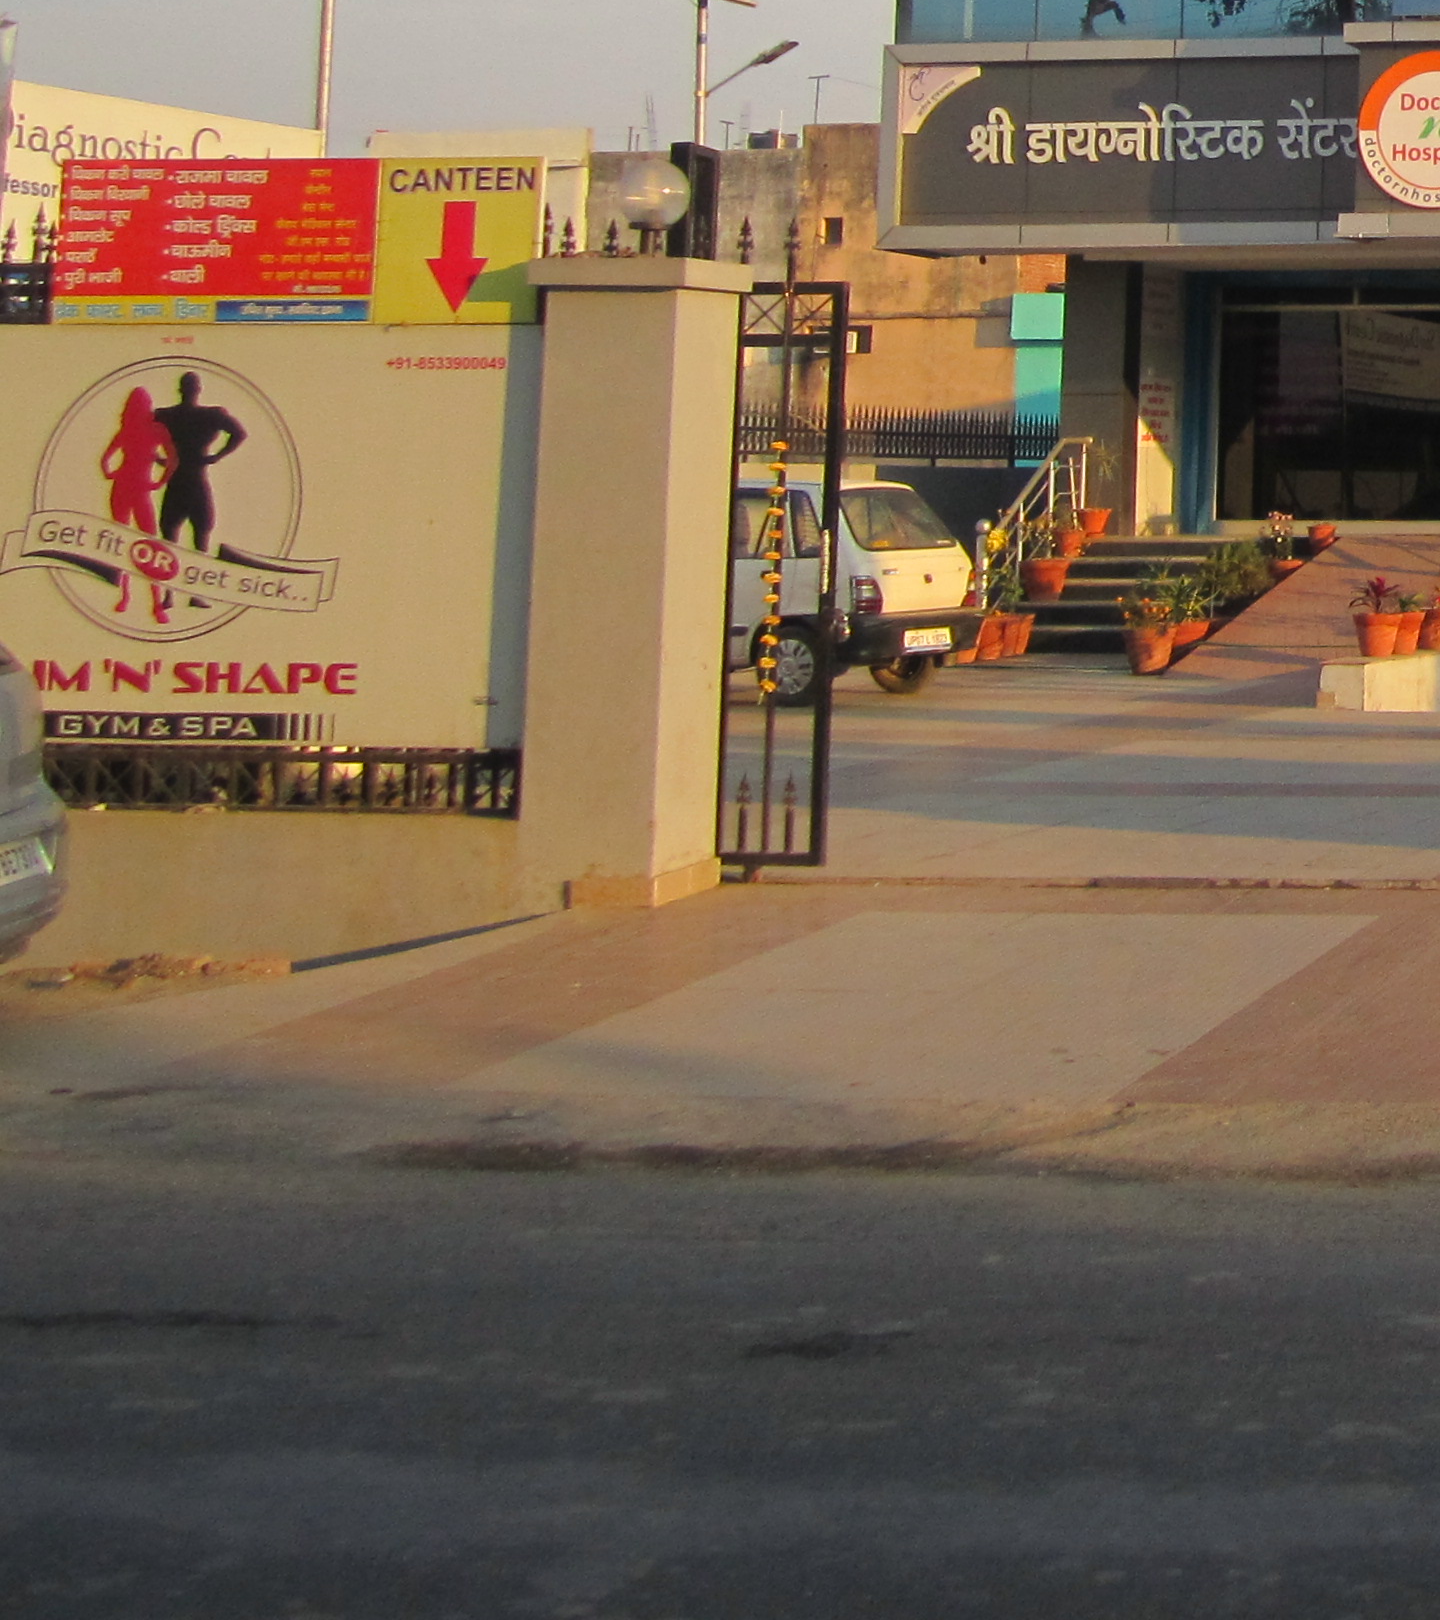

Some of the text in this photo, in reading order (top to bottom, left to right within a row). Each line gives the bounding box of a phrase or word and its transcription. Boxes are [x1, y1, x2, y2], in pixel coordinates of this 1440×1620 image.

[967, 97, 1358, 164] श्री डायग्नोस्टिक सेंटर
[390, 167, 536, 192] CANTEEN
[39, 519, 86, 547] Get
[96, 529, 126, 557] fit
[132, 543, 173, 573] OR
[184, 564, 231, 589] get
[104, 658, 359, 694] 'N' SHAPE
[59, 714, 258, 737] GYM & SPA
